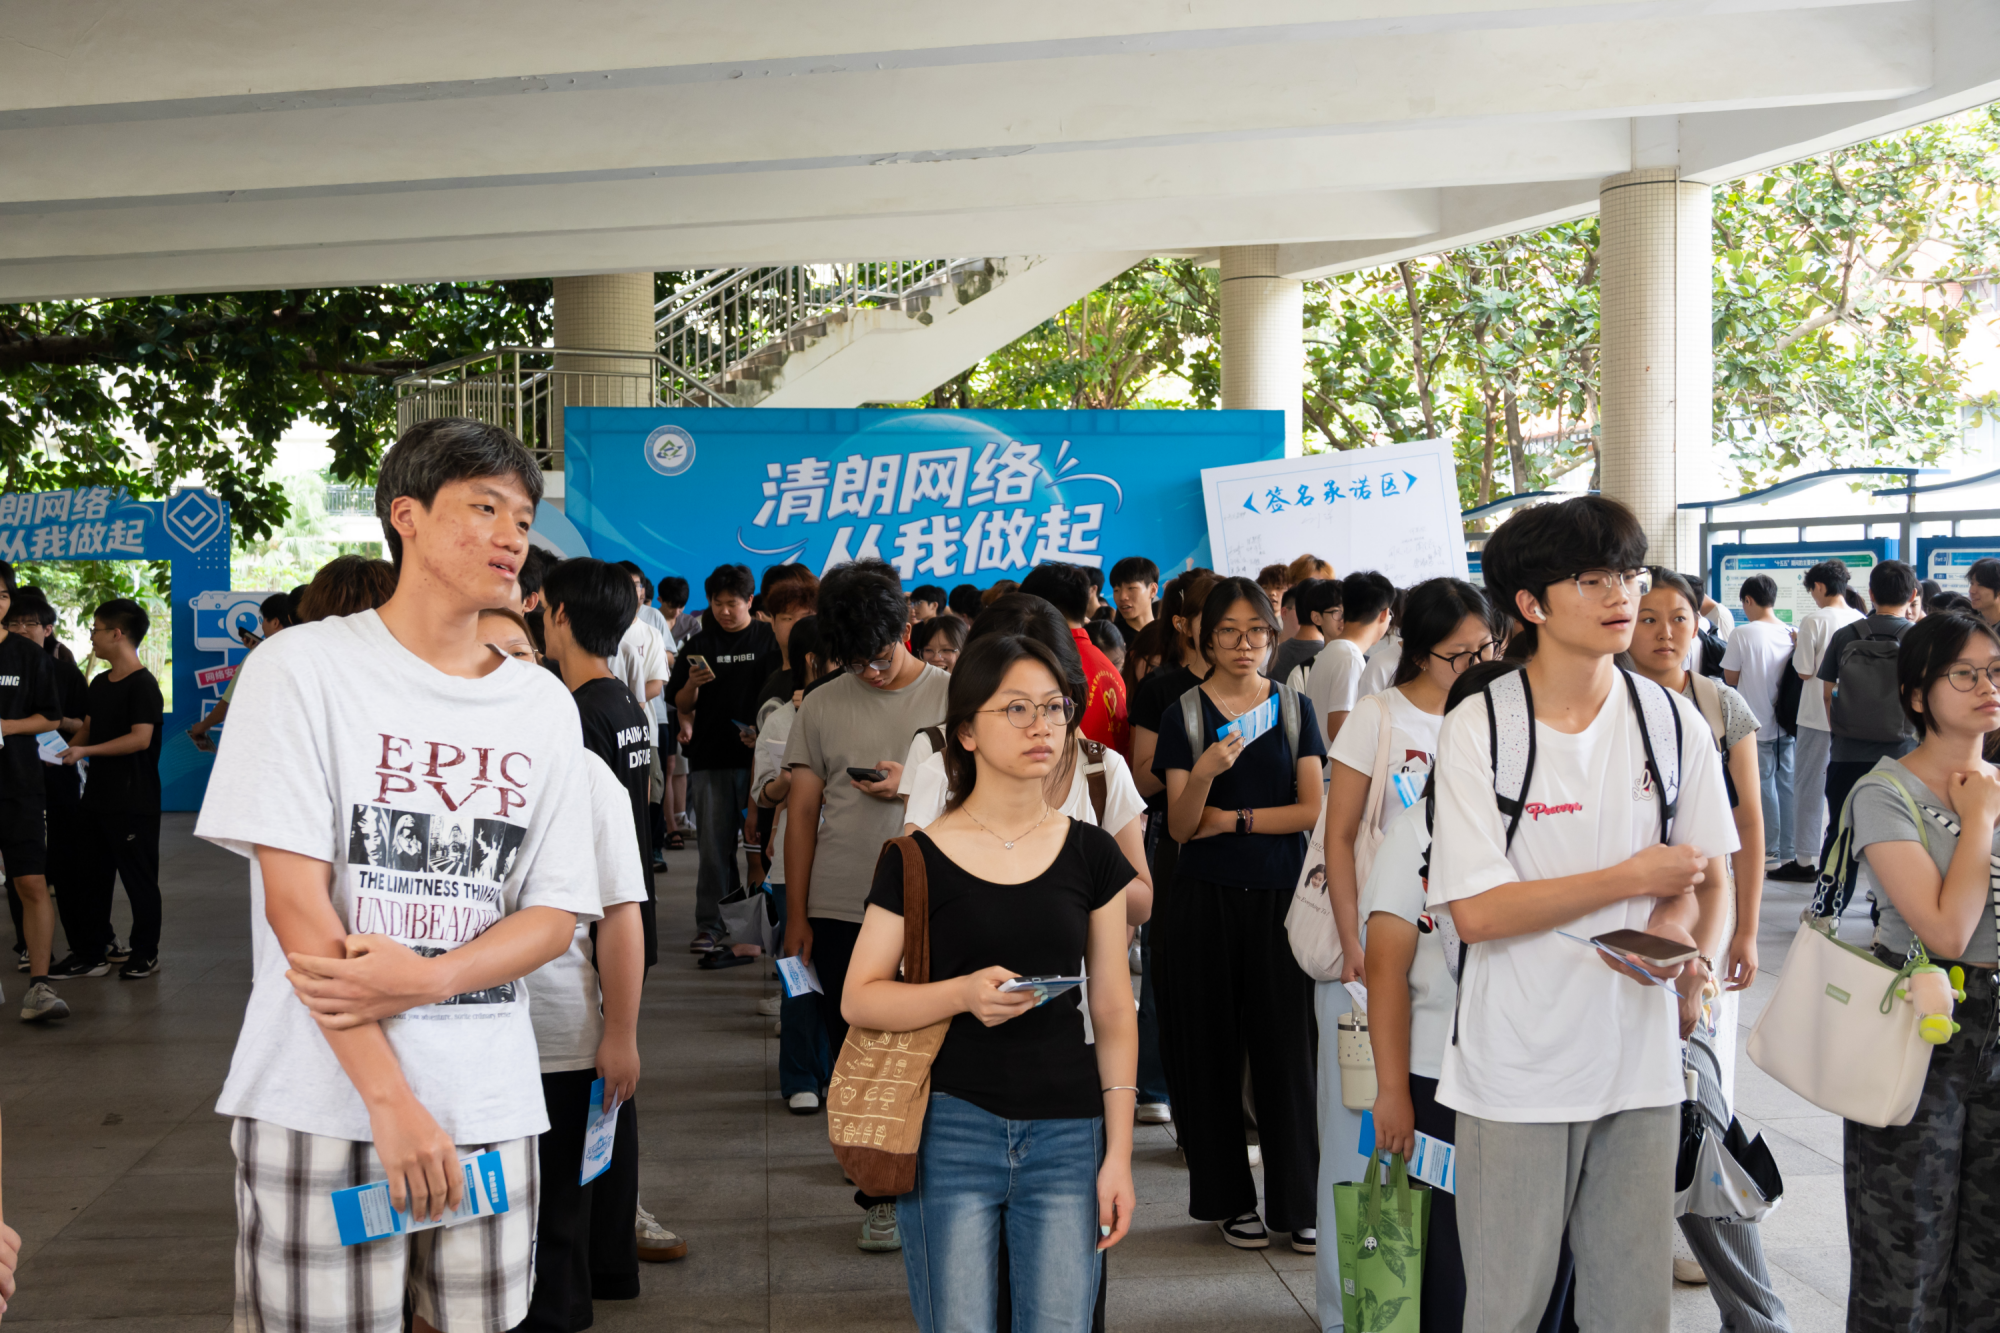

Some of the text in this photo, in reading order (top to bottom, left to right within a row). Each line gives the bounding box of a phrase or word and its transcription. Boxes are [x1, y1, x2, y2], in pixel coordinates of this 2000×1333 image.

[752, 440, 1043, 527] 清朗网络
[1265, 472, 1401, 514] 签名承诺区
[0, 519, 145, 562] 从我做起
[818, 503, 1104, 582] 从我做起
[205, 667, 239, 682] 网络安
[375, 733, 532, 788] EPIC
[372, 771, 527, 818] PVP
[359, 871, 385, 890] THE
[387, 876, 459, 898] LIMITNESS
